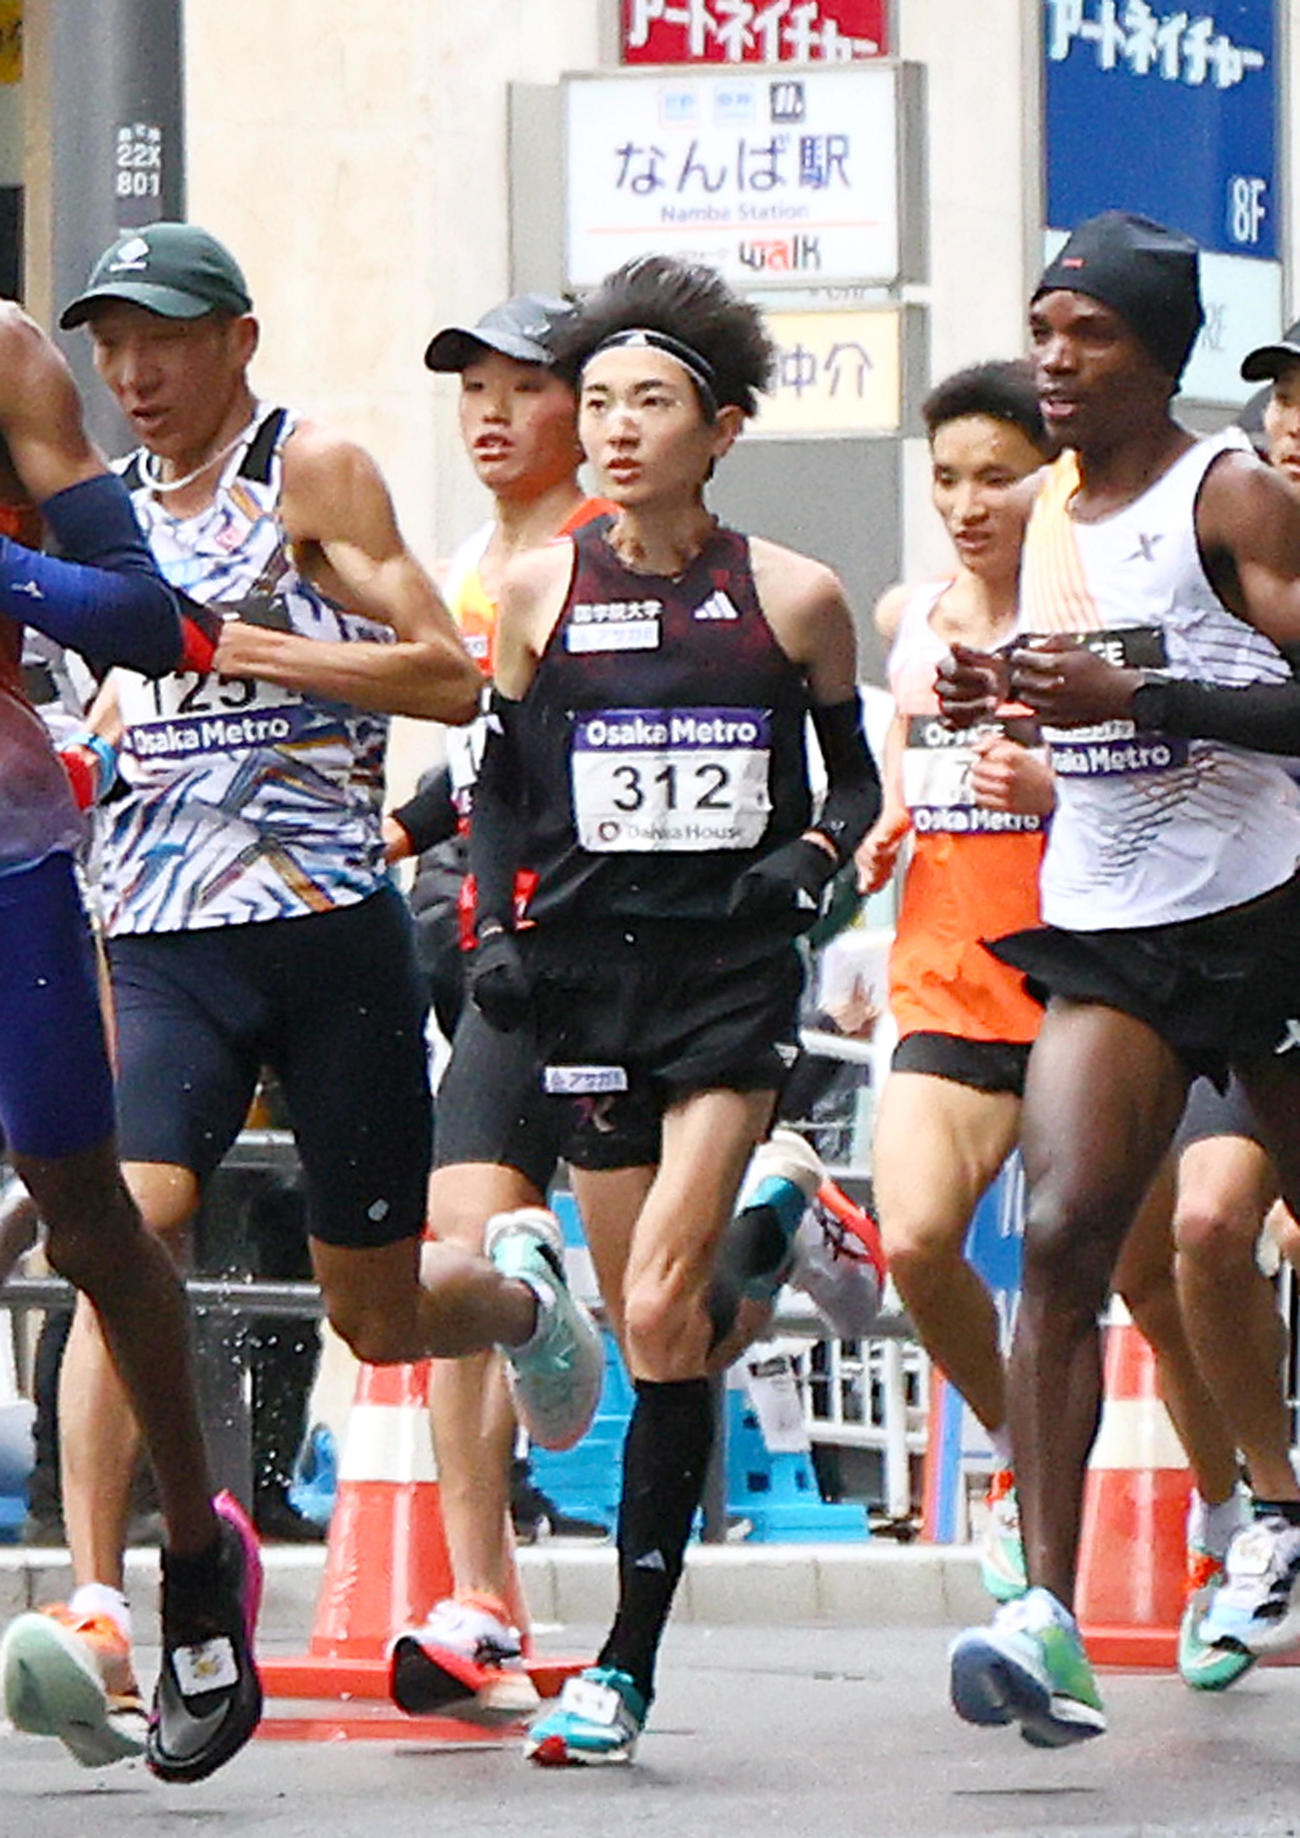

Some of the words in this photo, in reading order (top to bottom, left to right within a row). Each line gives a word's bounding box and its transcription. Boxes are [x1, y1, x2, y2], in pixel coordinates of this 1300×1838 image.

[614, 134, 852, 195] なんば駅
[117, 171, 160, 197] 801
[661, 205, 731, 223] Namba
[737, 201, 810, 220] Station
[1233, 177, 1267, 243] 8F
[202, 718, 290, 747] Metro
[587, 717, 668, 745] Osaka
[671, 718, 758, 744] Metro
[1088, 744, 1171, 773] Metro
[612, 763, 732, 812] 312
